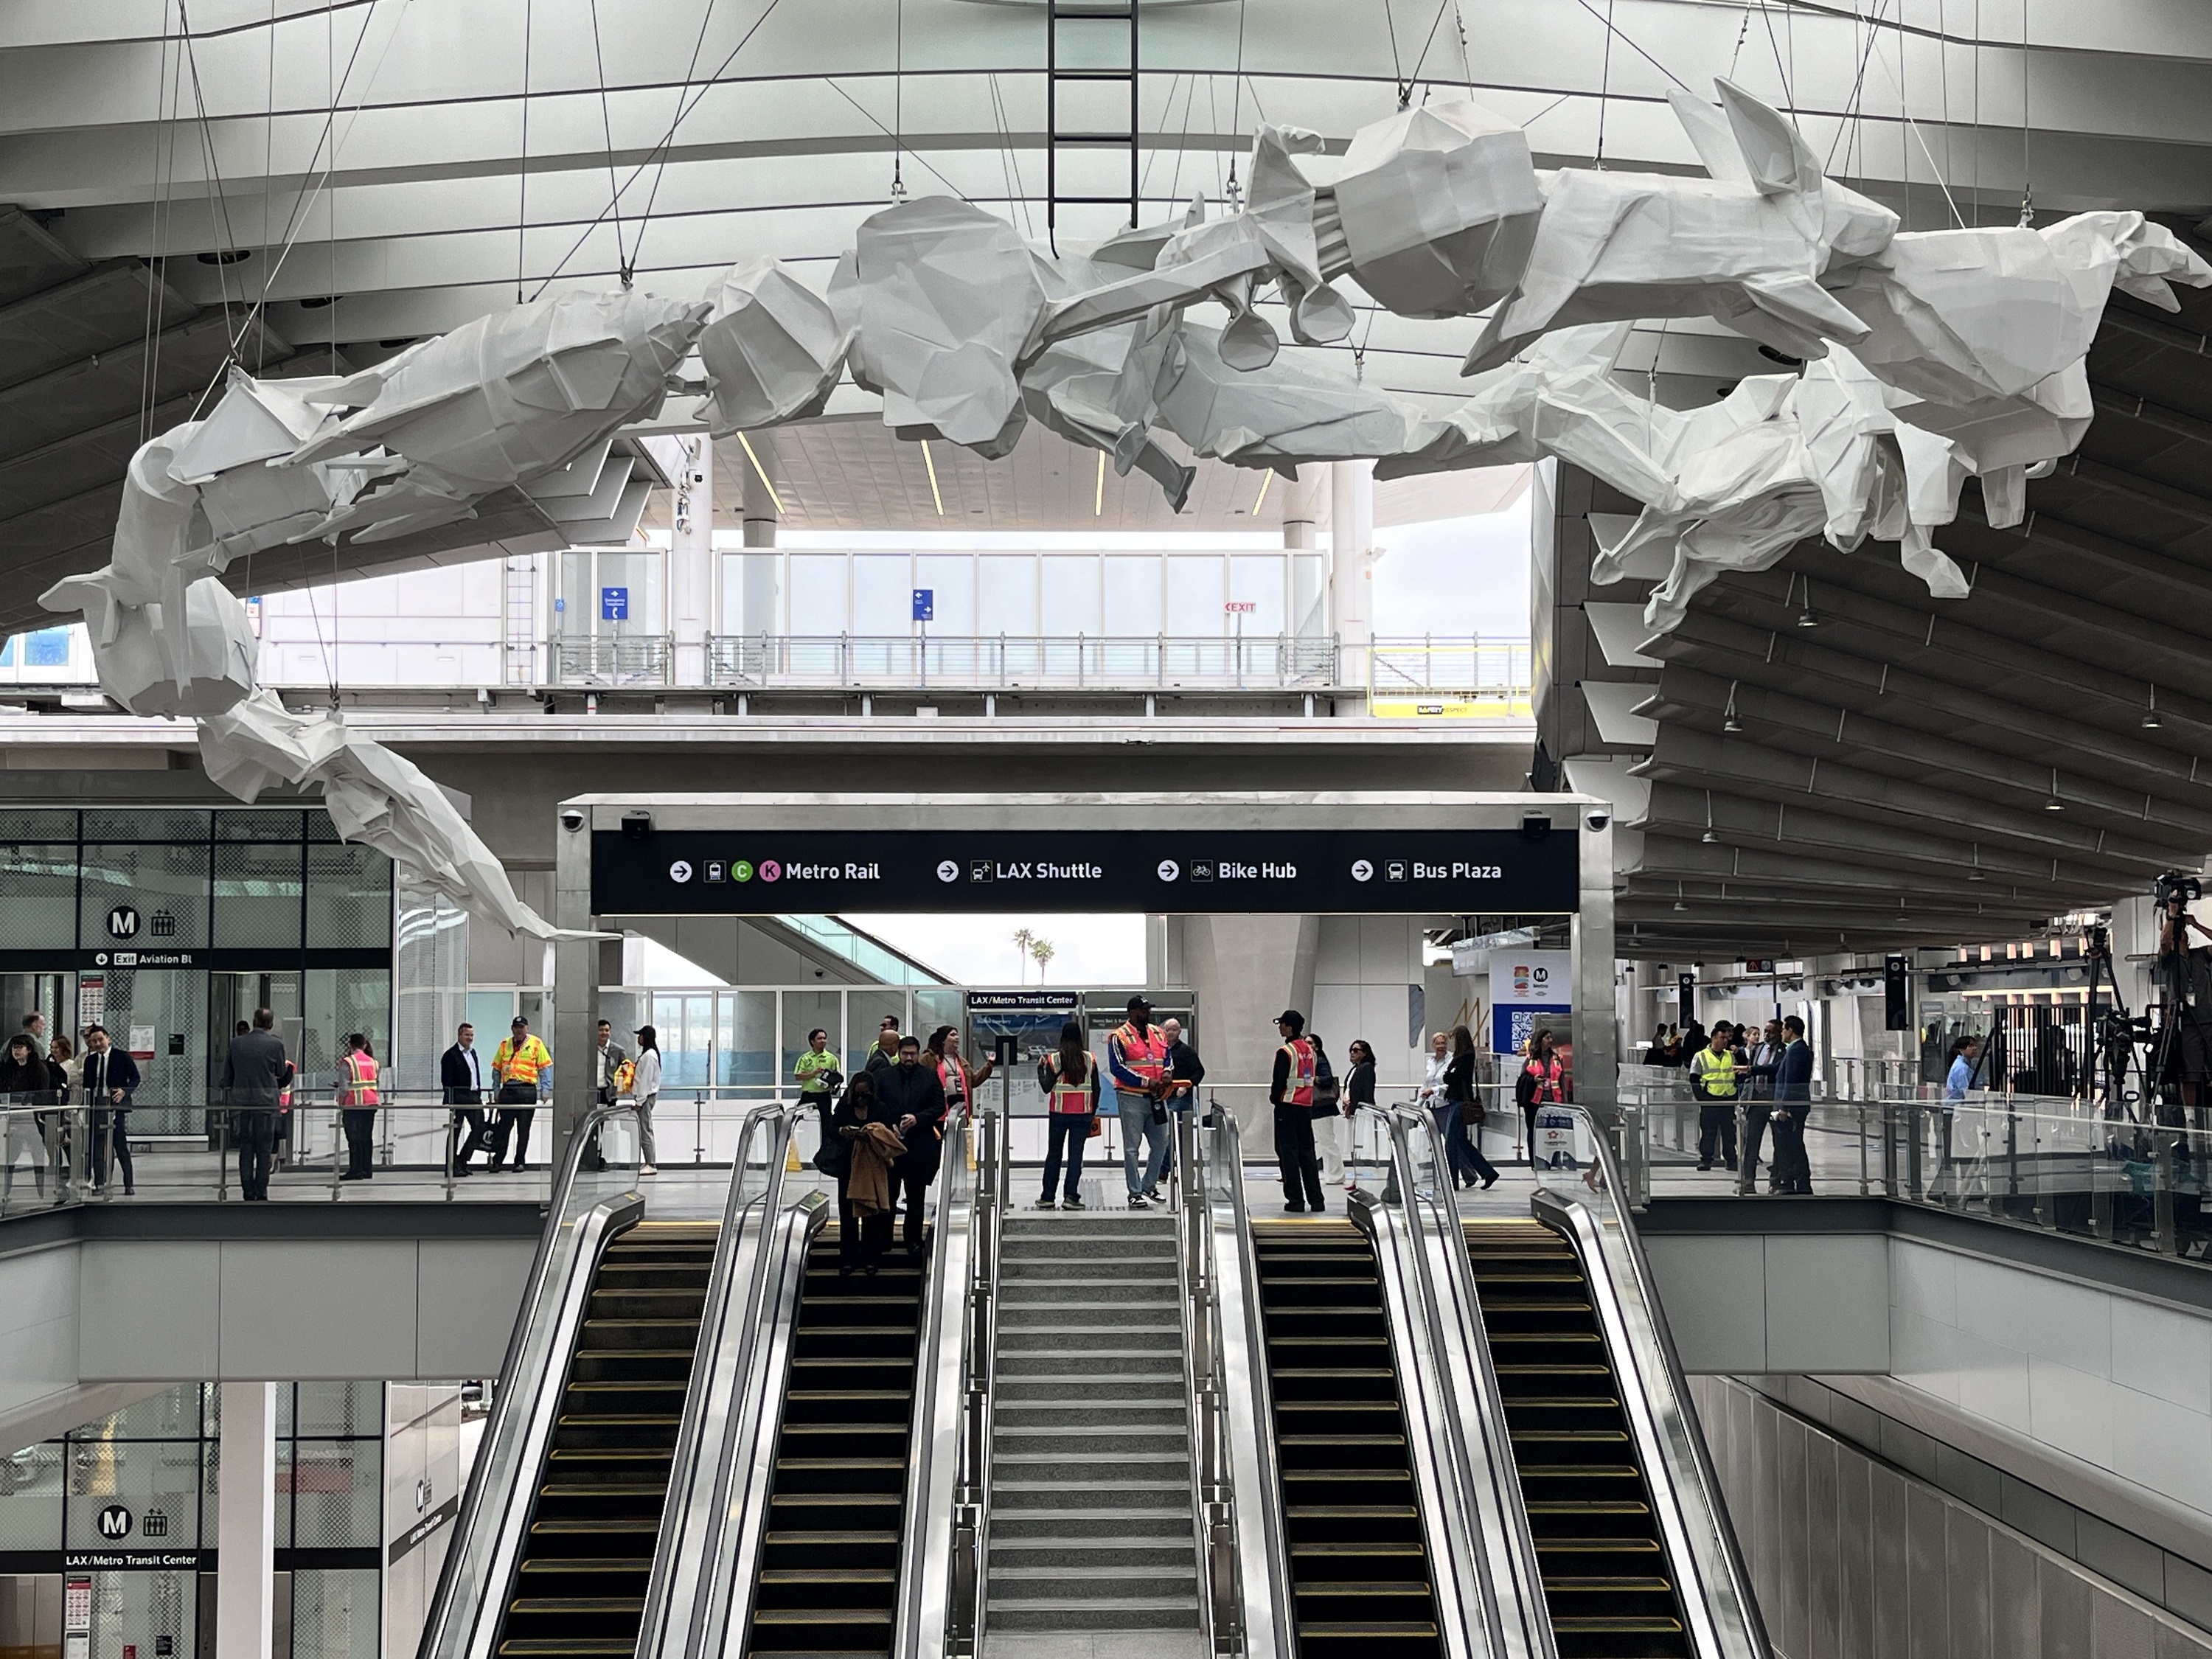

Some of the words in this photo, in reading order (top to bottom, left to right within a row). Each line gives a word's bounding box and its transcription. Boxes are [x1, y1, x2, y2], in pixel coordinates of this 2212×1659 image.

[1231, 602, 1256, 612] EXIT
[737, 865, 747, 878] C
[765, 864, 776, 877] K
[786, 863, 840, 879] Metro
[845, 863, 880, 879] Rail
[997, 863, 1032, 878] LAX
[1036, 863, 1102, 878] Shuttle
[1219, 863, 1258, 878] Bike
[1262, 863, 1297, 878] Hub
[1413, 863, 1447, 878] Bus
[1453, 863, 1502, 878] Plaza
[112, 911, 135, 933] M
[116, 954, 135, 964] Exit
[139, 954, 179, 964] Aviation
[181, 954, 192, 964] Bl
[1535, 970, 1547, 980] M
[971, 996, 1016, 1004] LAX/Metro
[1018, 995, 1045, 1004] Transit
[1046, 995, 1074, 1004] Center
[103, 1512, 126, 1534] M
[66, 1556, 123, 1565] LAX/Metro
[126, 1555, 160, 1565] Transit
[163, 1554, 197, 1565] Center
